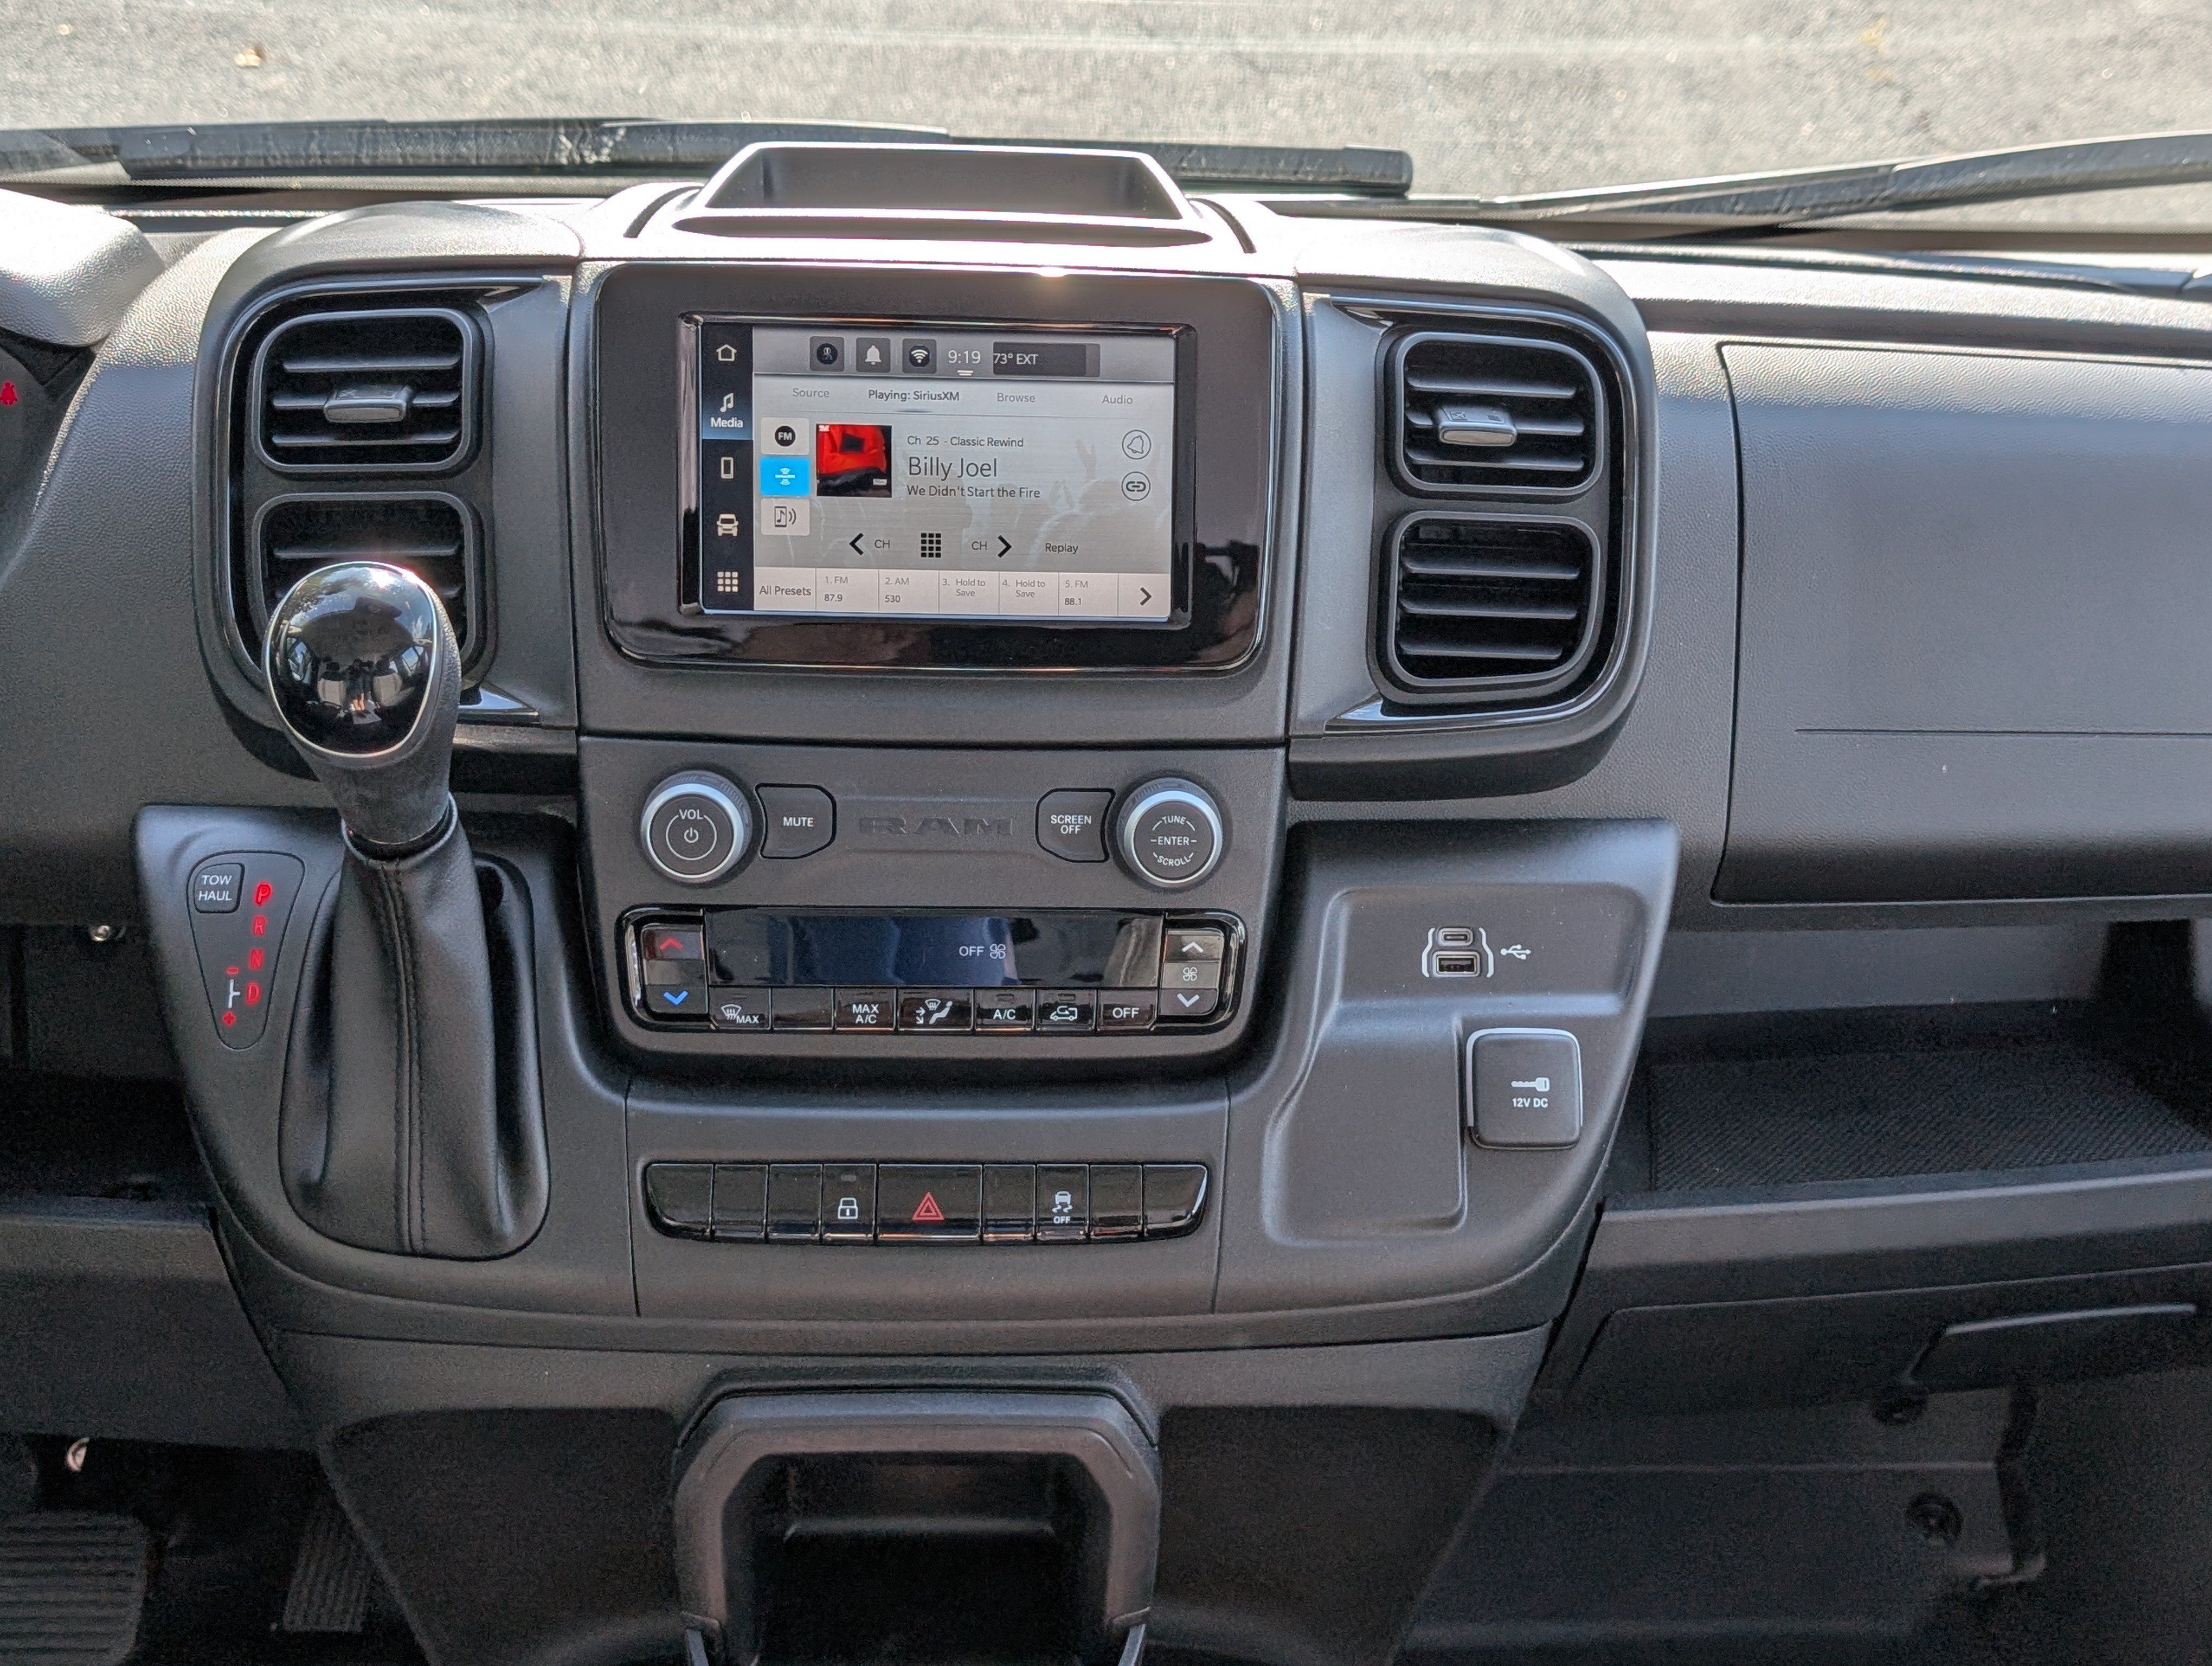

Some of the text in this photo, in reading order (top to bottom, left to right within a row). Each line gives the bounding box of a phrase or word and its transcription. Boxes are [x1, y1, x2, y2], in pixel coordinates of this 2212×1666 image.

[948, 350, 981, 364] 9:19
[993, 353, 1038, 365] 73° EXT
[793, 388, 829, 398] Source
[868, 390, 960, 401] Playing: SiriusXM
[997, 393, 1036, 402] Browse
[1102, 395, 1133, 405] Audio
[710, 417, 743, 428] Media
[778, 432, 792, 440] FM
[907, 435, 921, 445] Ch
[926, 436, 939, 446] 25
[950, 437, 985, 446] Classic
[987, 437, 1024, 447] Rewind
[909, 457, 997, 481] Billy Joel
[907, 486, 1040, 498] We Didn't Start the Fire
[874, 540, 890, 548] CH
[971, 541, 987, 550] CH
[1045, 543, 1079, 554] Replay
[834, 576, 848, 584] FM
[885, 577, 909, 585] 2. AM
[942, 578, 950, 586] 3.
[956, 578, 975, 586] Hold
[1002, 579, 1011, 587] 4.
[1015, 579, 1035, 587] Hold
[1065, 580, 1088, 588] 5. FM
[760, 586, 811, 596] All Presets
[956, 589, 975, 597] Save
[824, 593, 843, 603] 87.9
[884, 594, 901, 603] 530
[1065, 598, 1082, 606] 88.1
[679, 809, 704, 820] VOL
[1051, 815, 1092, 824] SCREEN
[783, 817, 814, 827] MUTE
[1162, 815, 1187, 825] TUNE
[859, 817, 1013, 835] RAM
[1060, 825, 1081, 834] OFF
[1157, 855, 1192, 867] SCROLL
[202, 875, 232, 885] TOW
[198, 890, 233, 901] HAUL
[256, 883, 271, 905] P
[254, 917, 266, 935] R
[959, 946, 984, 957] OFF
[250, 949, 263, 969] N
[247, 983, 261, 1004] D
[852, 1004, 879, 1014] MAX
[1112, 1007, 1139, 1018] OFF
[736, 1015, 759, 1024] MAX
[855, 1014, 877, 1024] A/C
[993, 1009, 1016, 1020] A/C
[1512, 1098, 1548, 1107] 12V DC
[1053, 1216, 1071, 1224] OFF
